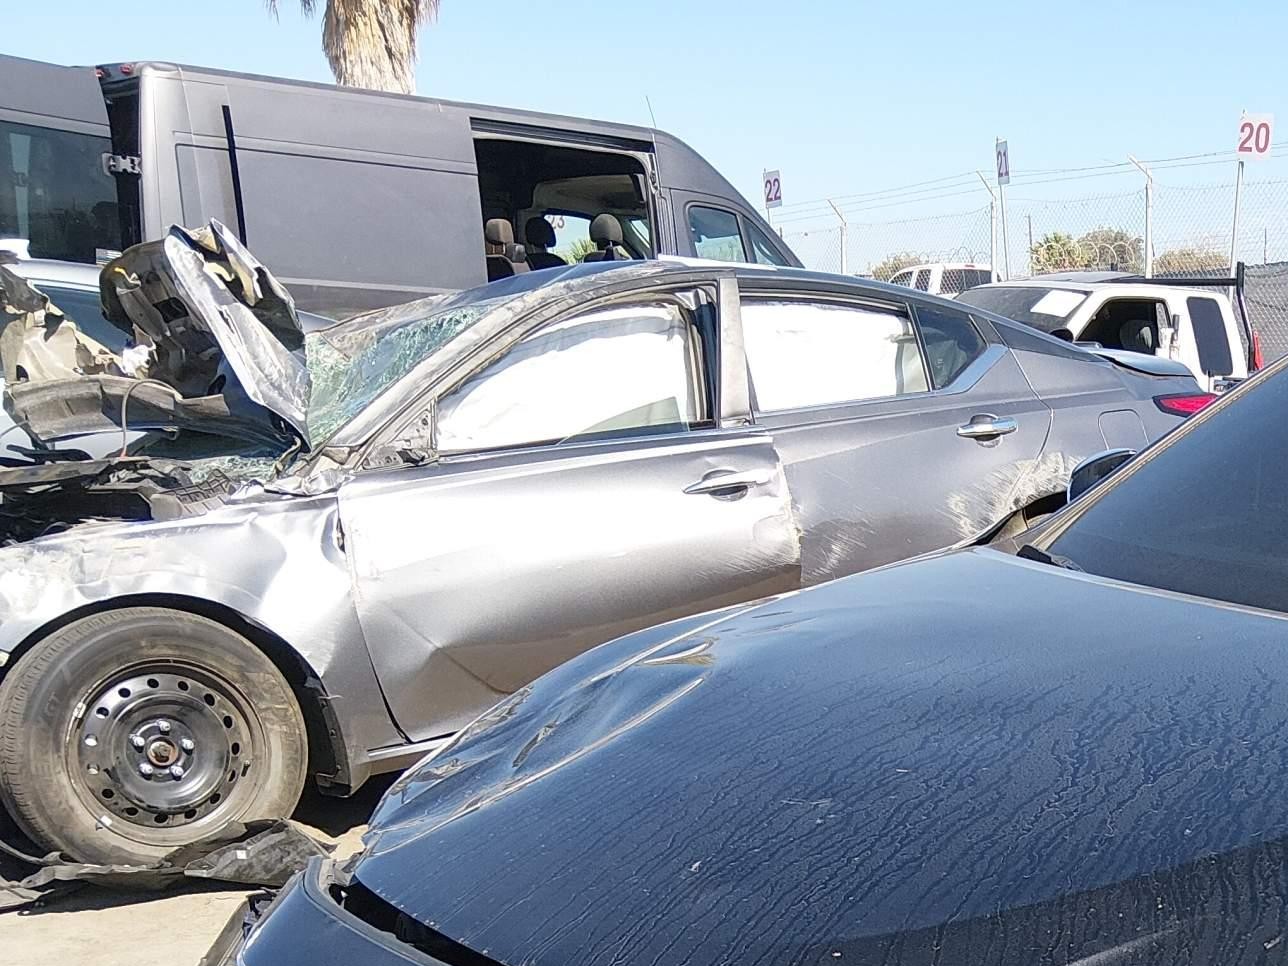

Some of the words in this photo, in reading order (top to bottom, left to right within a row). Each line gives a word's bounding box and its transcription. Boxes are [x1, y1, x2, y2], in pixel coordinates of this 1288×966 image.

[1238, 120, 1271, 155] 20
[997, 150, 1009, 177] 21
[765, 178, 781, 202] 22
